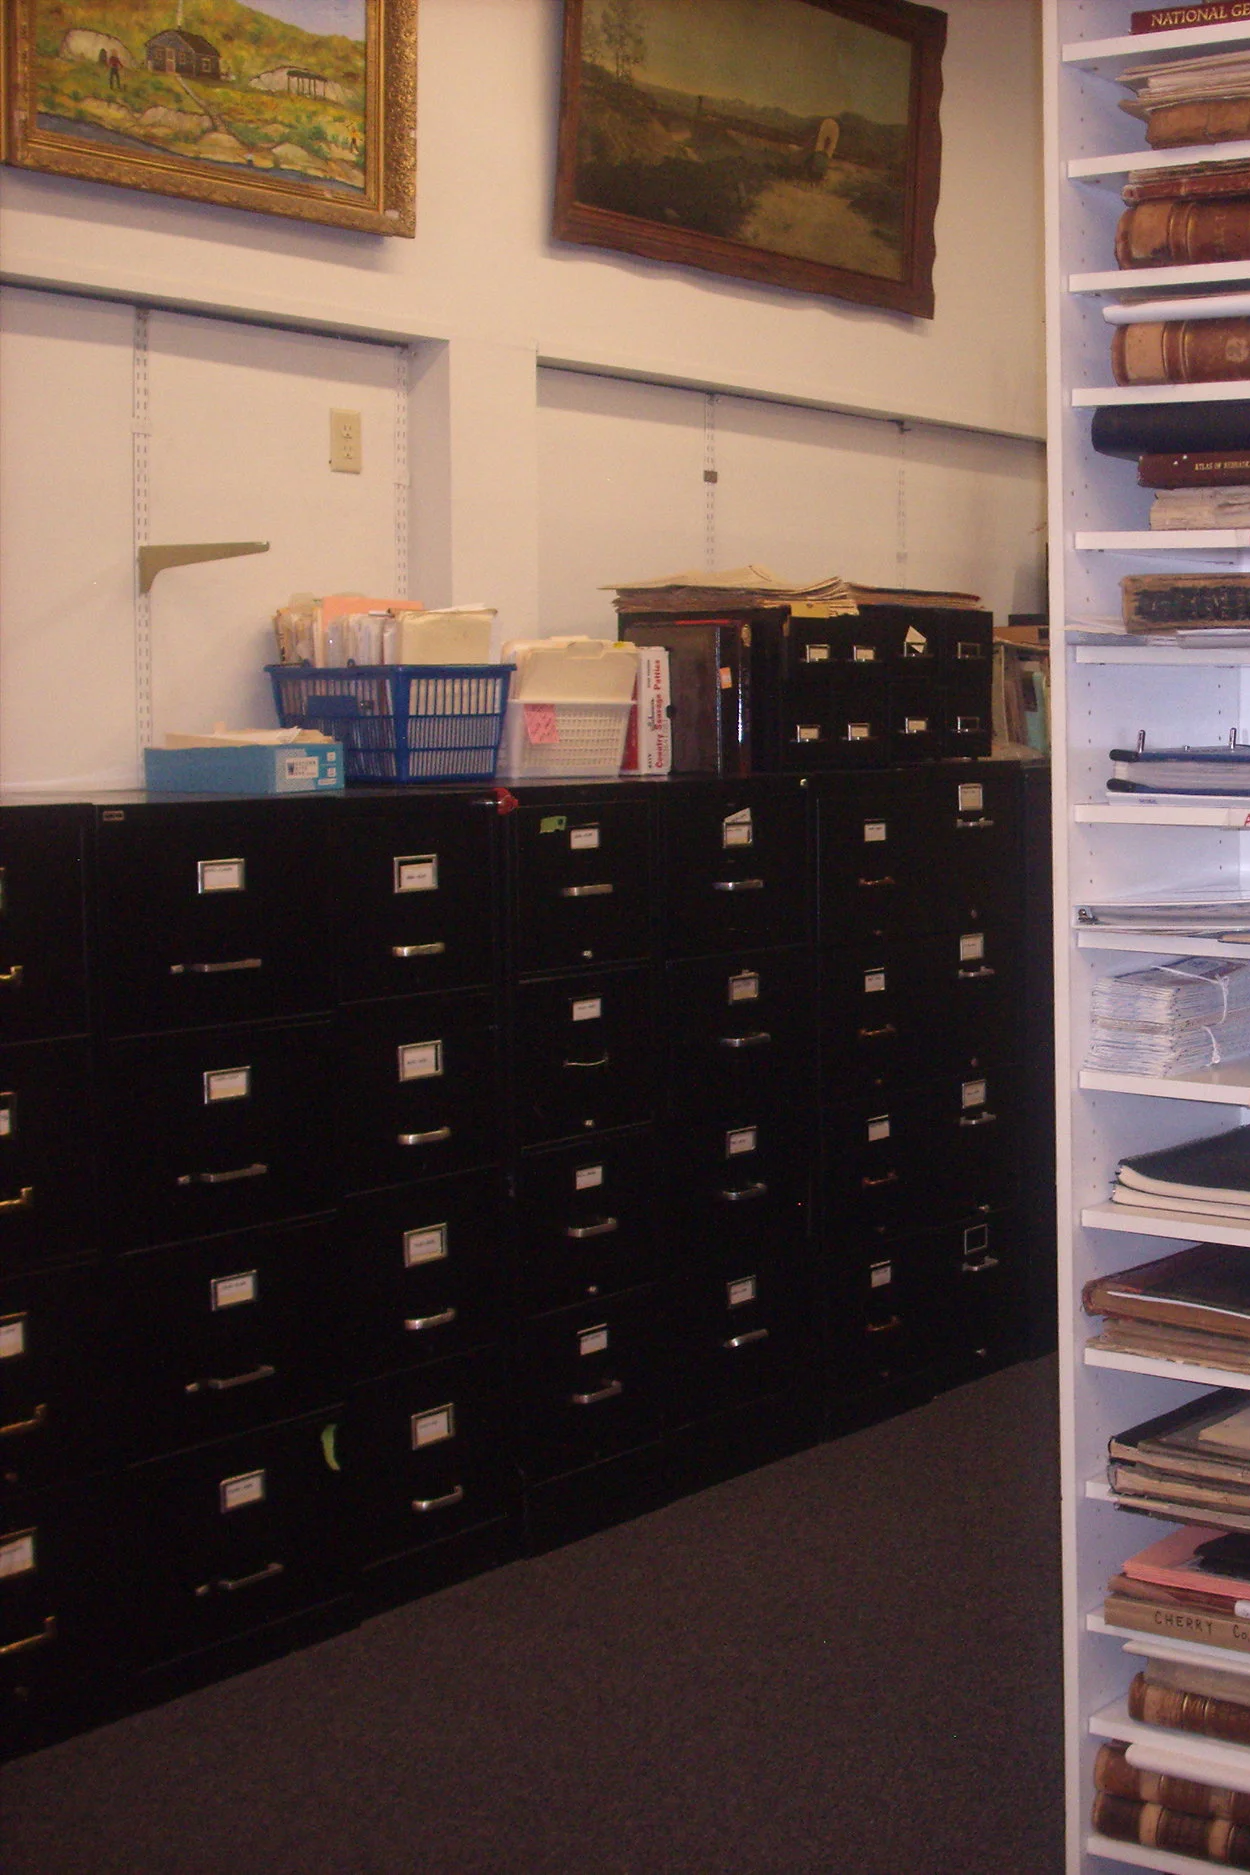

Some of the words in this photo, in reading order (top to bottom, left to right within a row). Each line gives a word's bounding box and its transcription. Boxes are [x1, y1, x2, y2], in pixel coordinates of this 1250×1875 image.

[1151, 3, 1227, 27] NATIONAL
[652, 659, 662, 691] Patties
[654, 694, 664, 731] Sausage
[655, 734, 665, 769] Country
[1154, 1610, 1213, 1635] CHERRY
